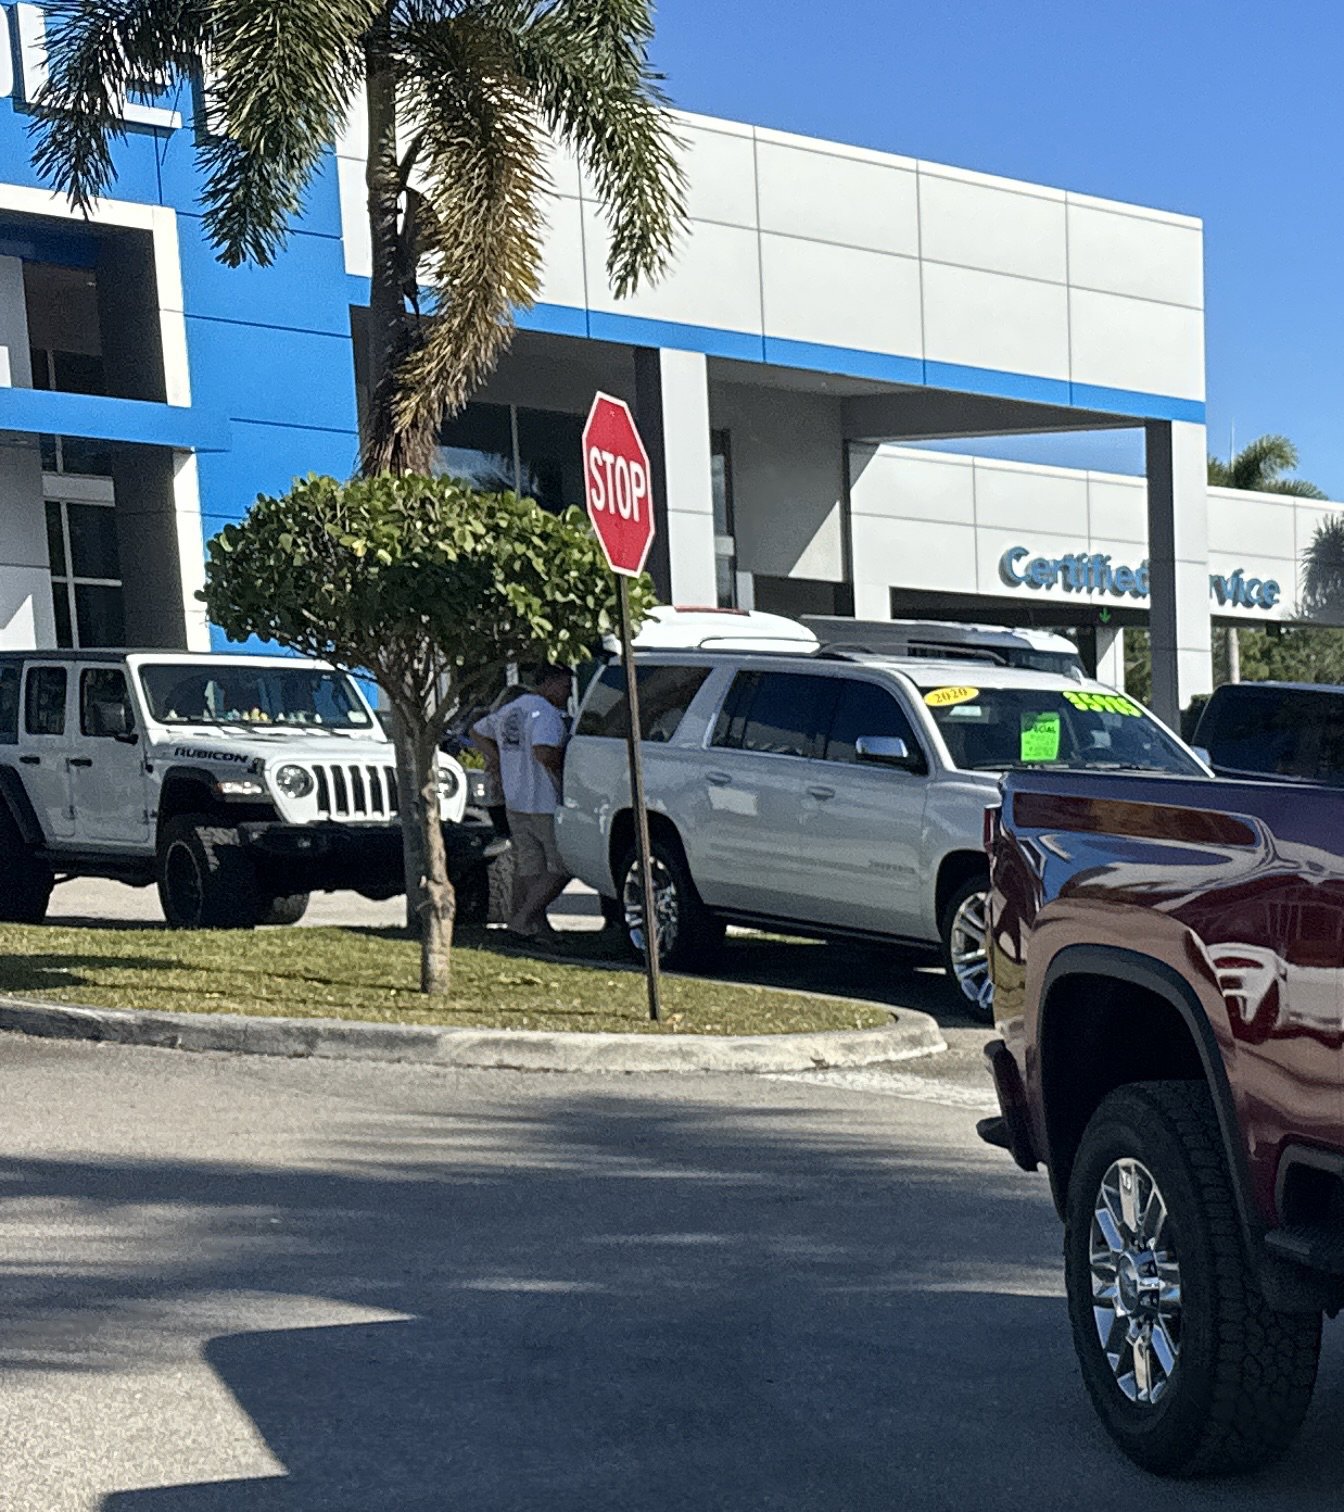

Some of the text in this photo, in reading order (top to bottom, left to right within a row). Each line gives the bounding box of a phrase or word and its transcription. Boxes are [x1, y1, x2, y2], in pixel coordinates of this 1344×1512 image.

[589, 446, 646, 522] STOP
[1208, 568, 1281, 610] rvice
[174, 747, 248, 763] RUBICON
